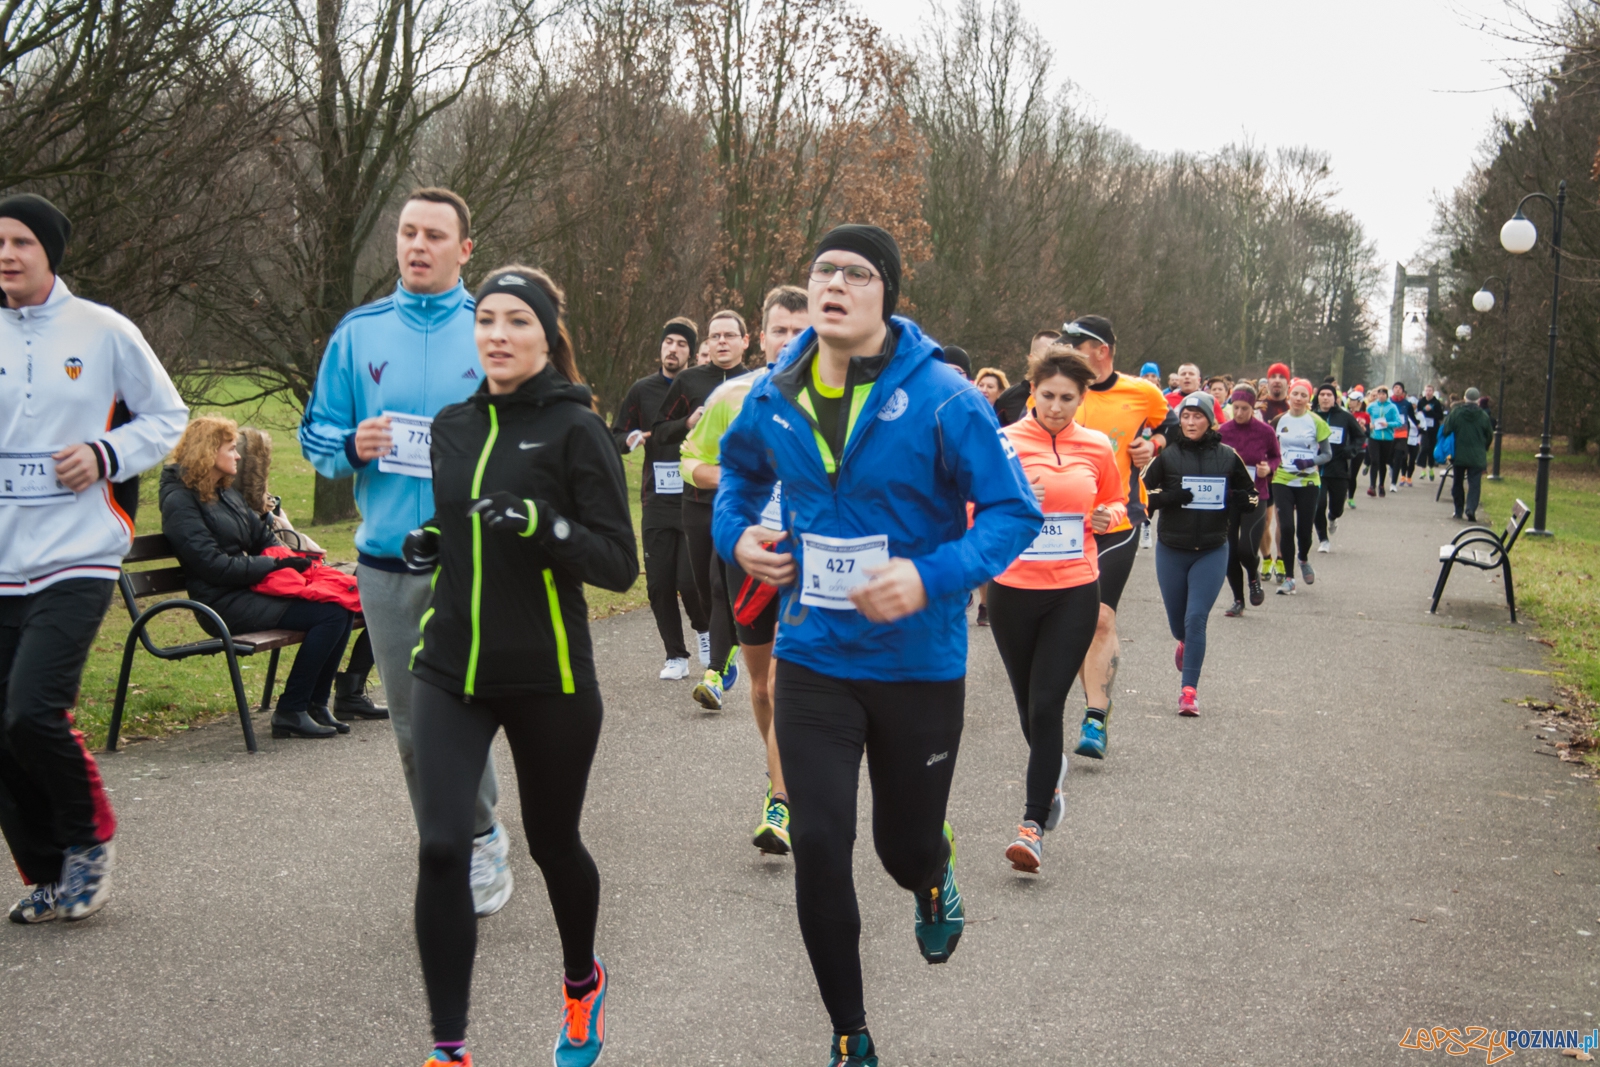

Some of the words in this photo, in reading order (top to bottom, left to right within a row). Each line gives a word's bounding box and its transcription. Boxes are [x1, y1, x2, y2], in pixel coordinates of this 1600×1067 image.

[18, 463, 47, 476] 771
[666, 470, 681, 478] 673
[1197, 484, 1213, 493] 130
[1041, 525, 1063, 536] 481
[825, 557, 856, 574] 427
